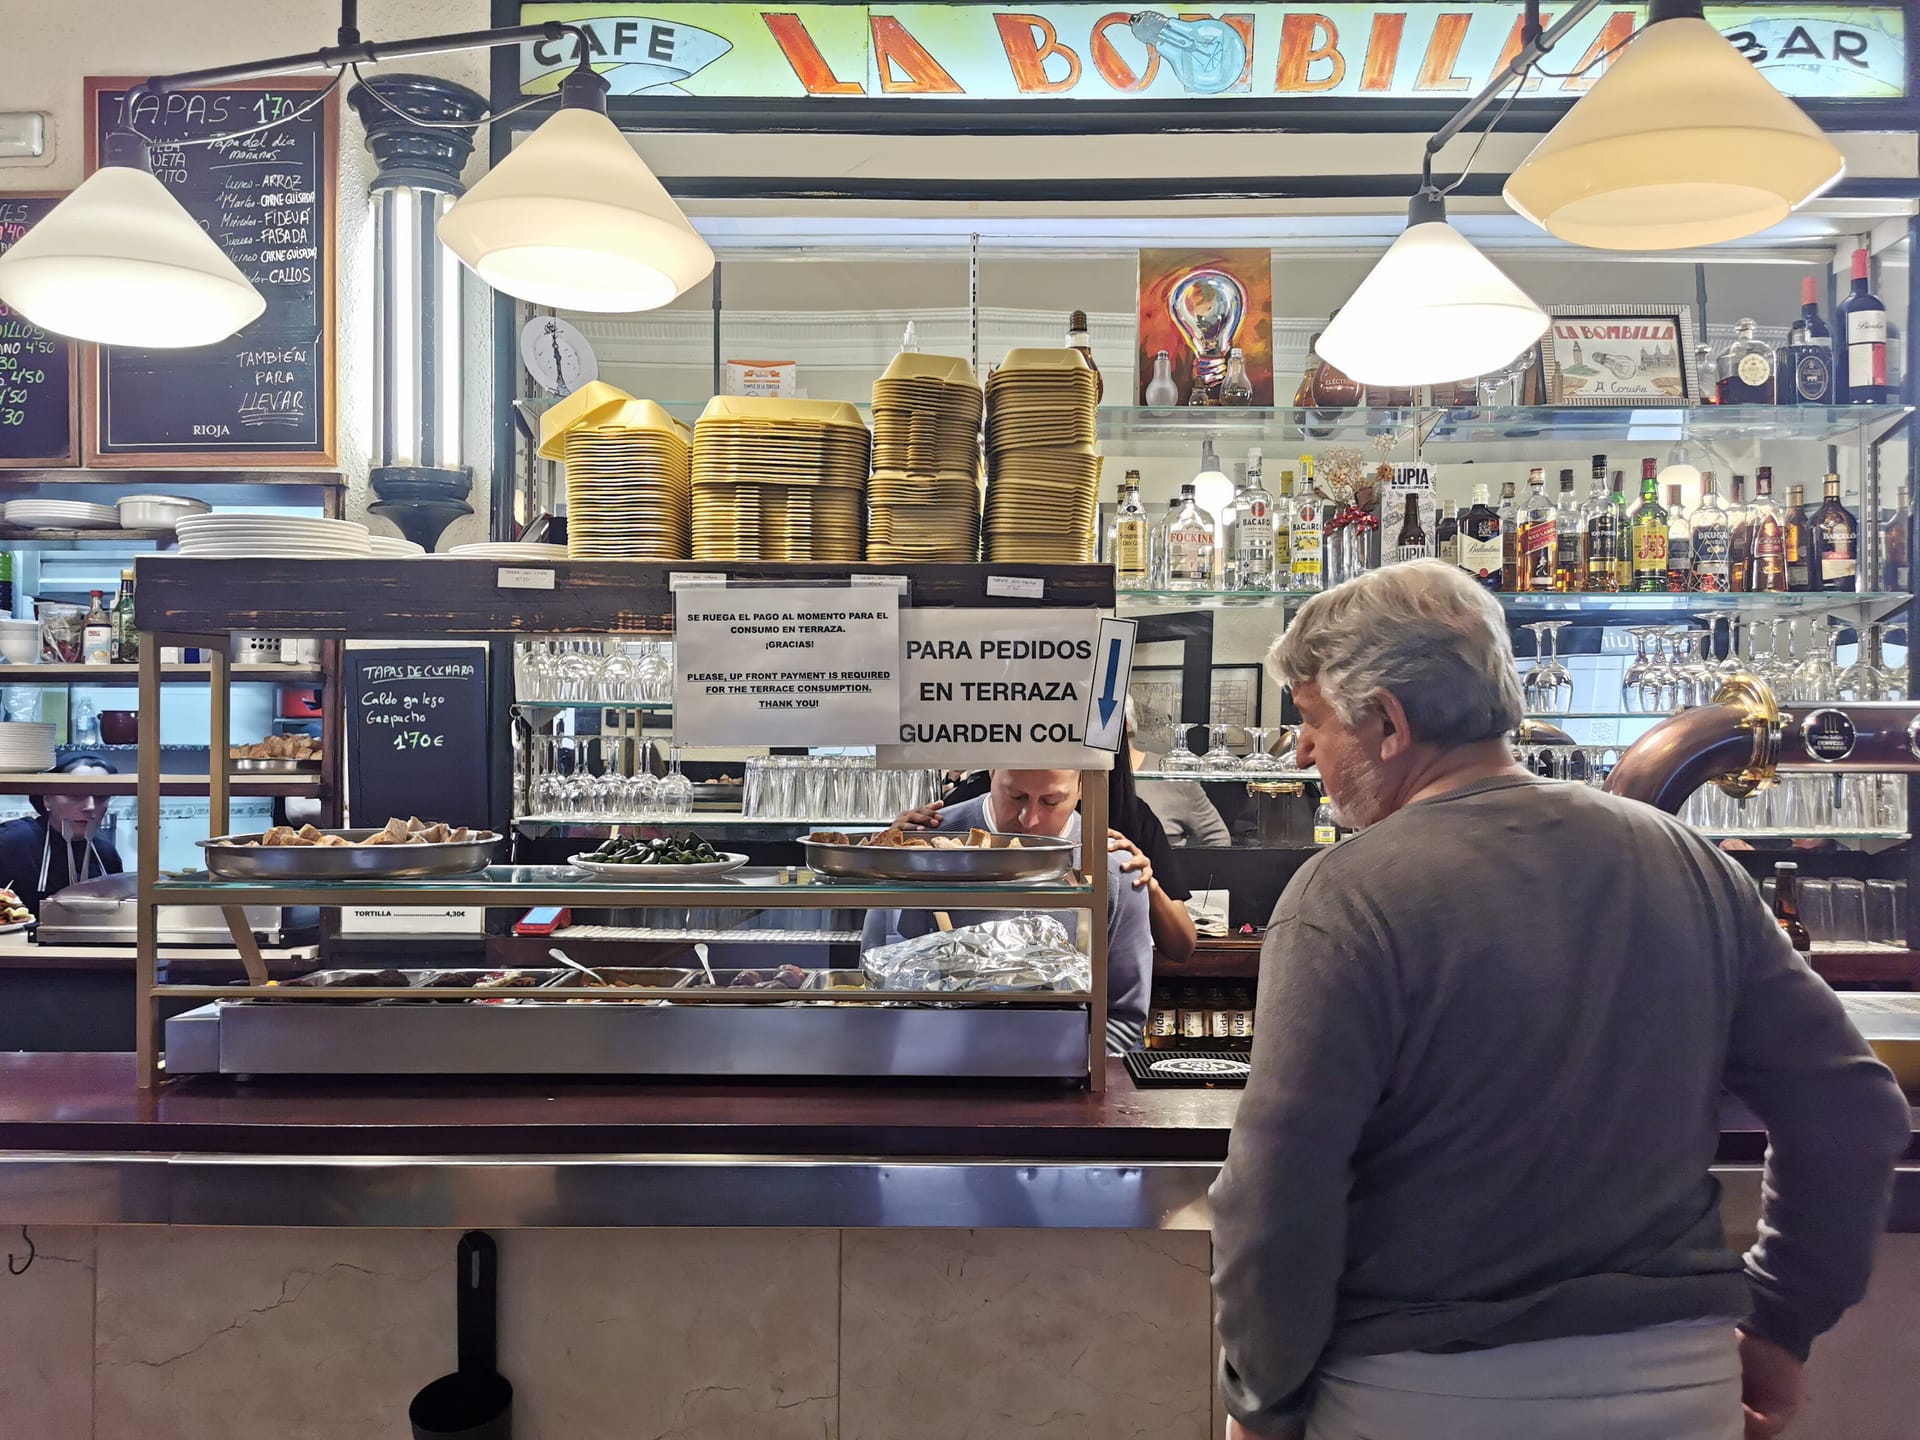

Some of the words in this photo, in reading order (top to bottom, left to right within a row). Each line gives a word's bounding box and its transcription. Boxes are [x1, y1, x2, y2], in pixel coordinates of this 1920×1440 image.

[533, 21, 676, 66] CAFE
[1725, 25, 1869, 69] BAR
[760, 12, 966, 94] LA
[114, 94, 231, 126] TAPAS
[152, 152, 186, 168] UETA
[261, 174, 302, 190] ARROZ
[260, 228, 307, 243] FABADA
[269, 267, 311, 284] CALLOS
[1554, 326, 1580, 339] LA
[1580, 326, 1674, 340] BOMBILLA
[255, 370, 295, 386] PARA
[1611, 381, 1648, 393] Coruña
[238, 391, 304, 413] LLEVAR
[193, 424, 230, 438] RIOJA
[1392, 468, 1429, 485] LUPIA
[688, 614, 702, 622] SE
[703, 614, 736, 622] RUEGA
[753, 613, 779, 621] PAGO
[782, 613, 795, 621] AL
[797, 613, 846, 621] MOMENTO
[876, 612, 888, 620] EL
[731, 626, 780, 634] CONSUMO
[765, 641, 814, 650] ¡GRACIAS!
[906, 640, 972, 659] PARA
[980, 640, 1092, 660] PEDIDOS
[363, 665, 404, 679] TAPAS
[407, 665, 422, 678] DE
[424, 665, 475, 677] CUCHARA
[687, 673, 727, 682] PLEASE,
[780, 672, 826, 680] PAYMENT
[841, 671, 890, 679] REQUIRED
[706, 686, 725, 694] FOR
[750, 685, 795, 693] TERRACE
[797, 684, 872, 693] CONSUMPTION.
[920, 682, 953, 701] EN
[961, 682, 1078, 701] TERRAZA
[361, 691, 398, 705] Caldo
[759, 700, 793, 708] THANK
[795, 700, 819, 708] YOU!
[366, 710, 427, 728] Gazpacho
[393, 731, 444, 750] 1'70€
[900, 723, 1022, 743] GUARDEN
[1030, 723, 1082, 743] COL
[445, 910, 465, 918] 4,30€
[1155, 1013, 1164, 1034] vida
[1236, 1013, 1244, 1035] vida
